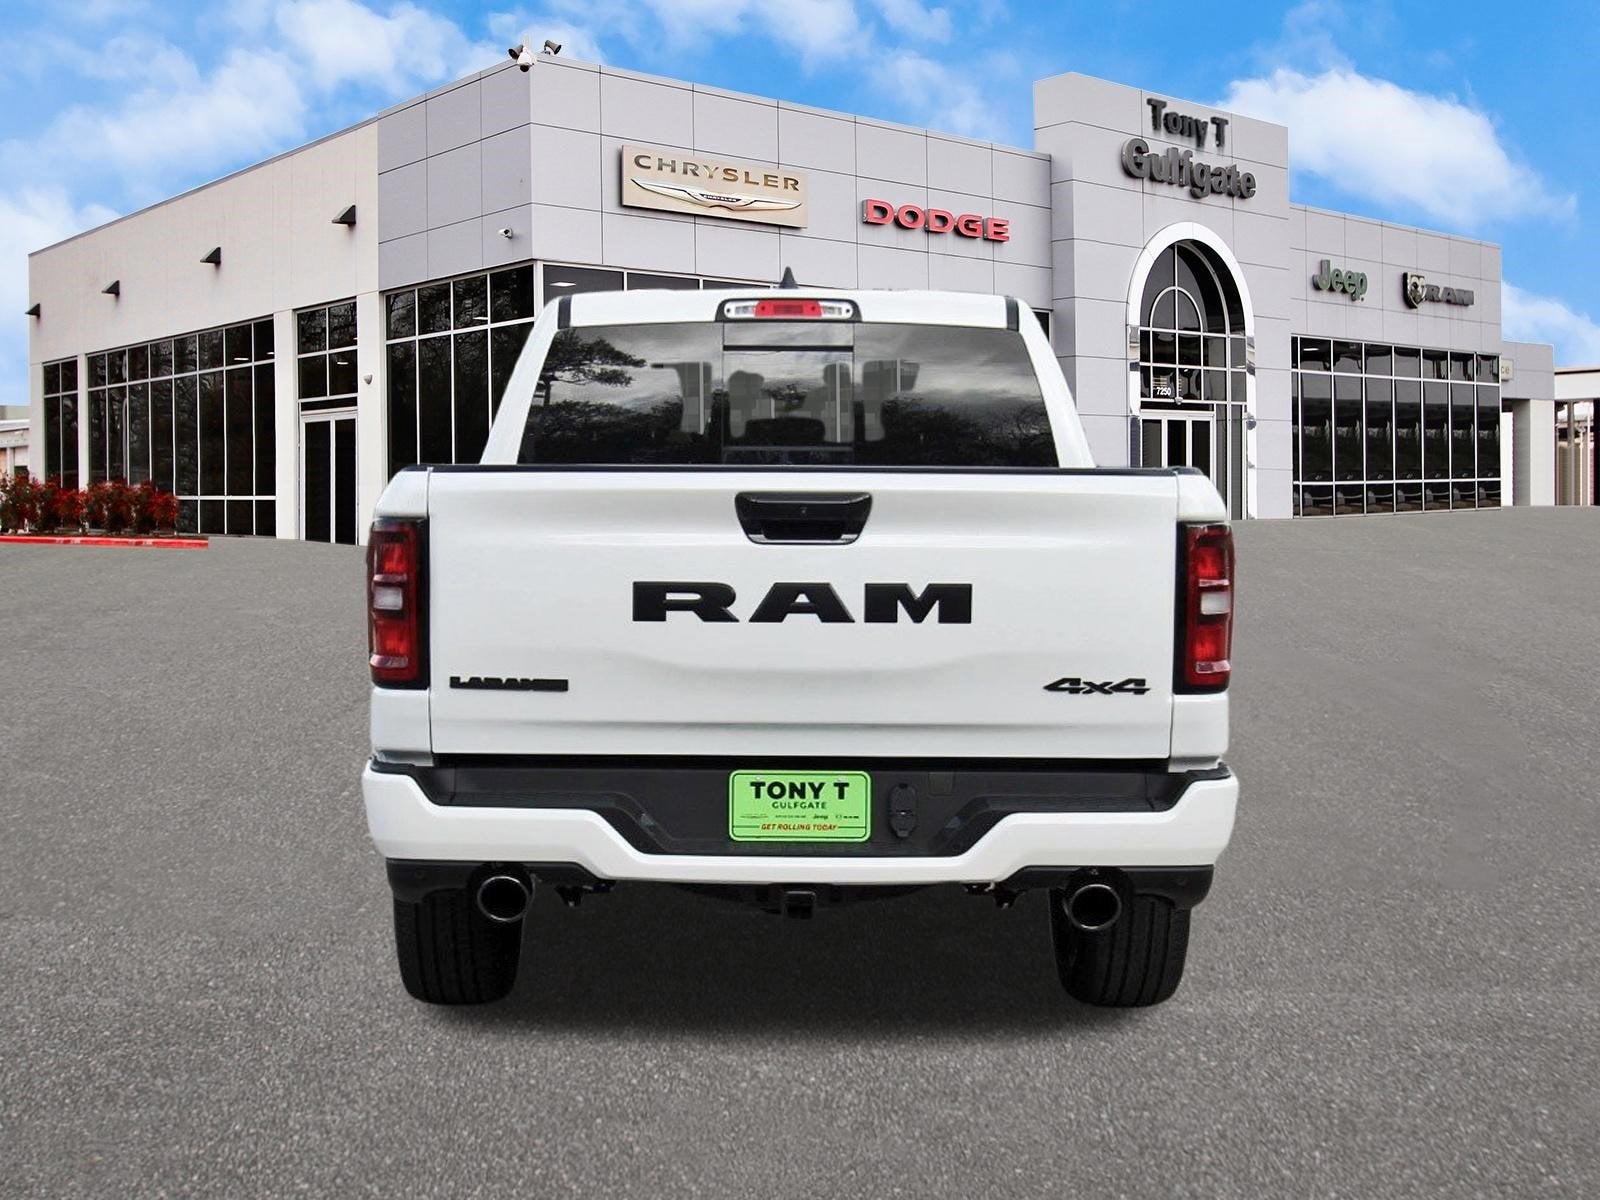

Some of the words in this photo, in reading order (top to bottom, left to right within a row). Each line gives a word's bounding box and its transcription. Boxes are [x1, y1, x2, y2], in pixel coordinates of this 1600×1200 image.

[1147, 98, 1208, 148] Tony
[1210, 116, 1229, 147] T
[634, 153, 800, 192] CHRYSLER
[1121, 137, 1256, 199] Gulfgate
[862, 198, 1010, 242] DODGE
[1312, 259, 1368, 302] Jeep
[1423, 283, 1474, 307] RAM
[632, 581, 973, 624] RAM
[750, 781, 826, 800] TONY
[833, 781, 850, 800] T
[771, 801, 827, 810] GULFGATE
[761, 823, 777, 831] GET
[777, 823, 811, 831] ROLLING
